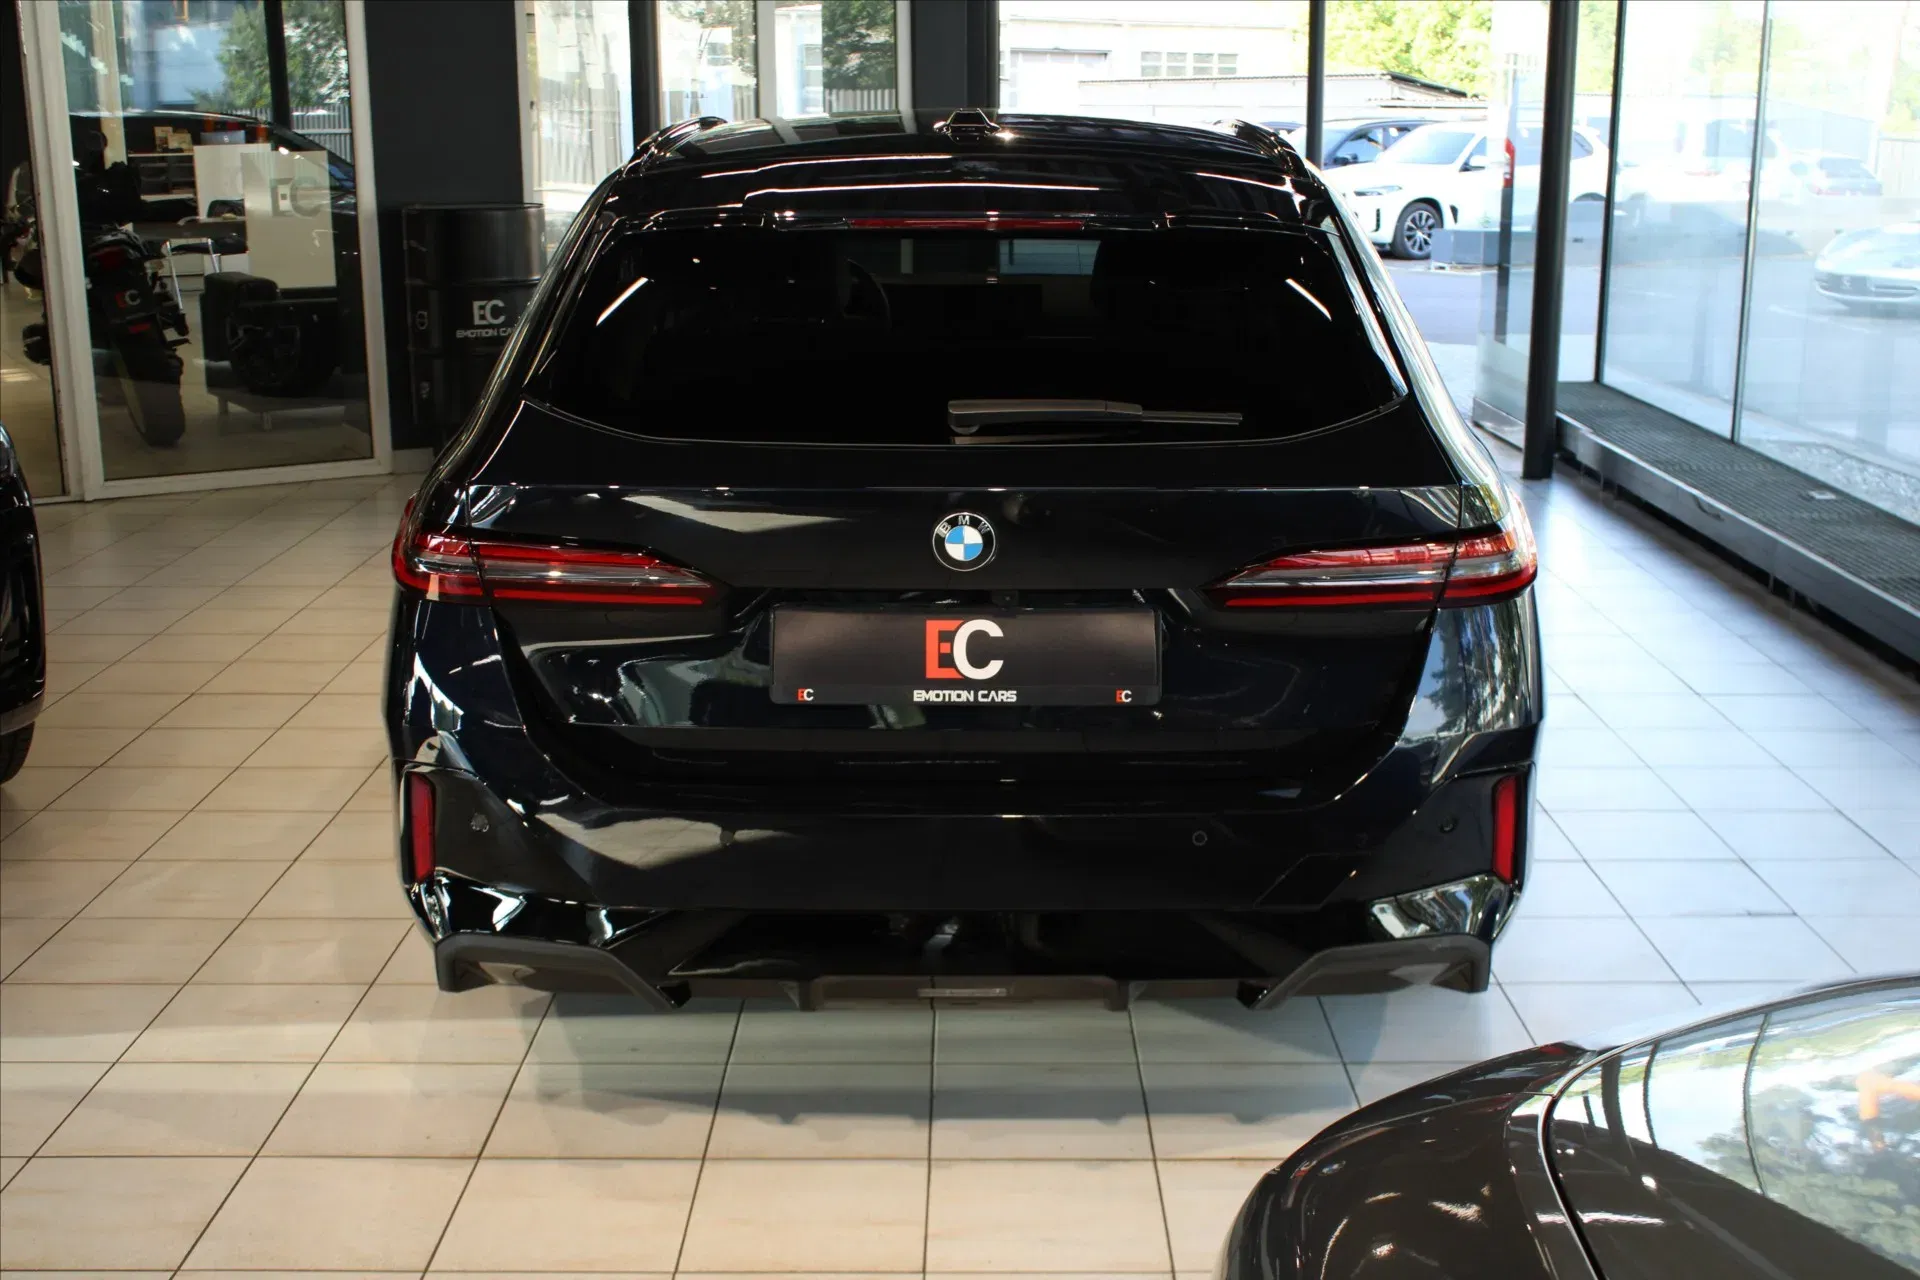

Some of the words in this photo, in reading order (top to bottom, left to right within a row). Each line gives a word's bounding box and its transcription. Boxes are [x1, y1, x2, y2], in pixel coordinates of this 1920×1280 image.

[472, 299, 506, 325] EC
[936, 514, 991, 538] BMW
[925, 618, 1004, 680] EC
[797, 688, 814, 701] EC
[913, 689, 974, 702] EMOTION
[977, 690, 1017, 702] CARS
[1115, 689, 1132, 703] EC
